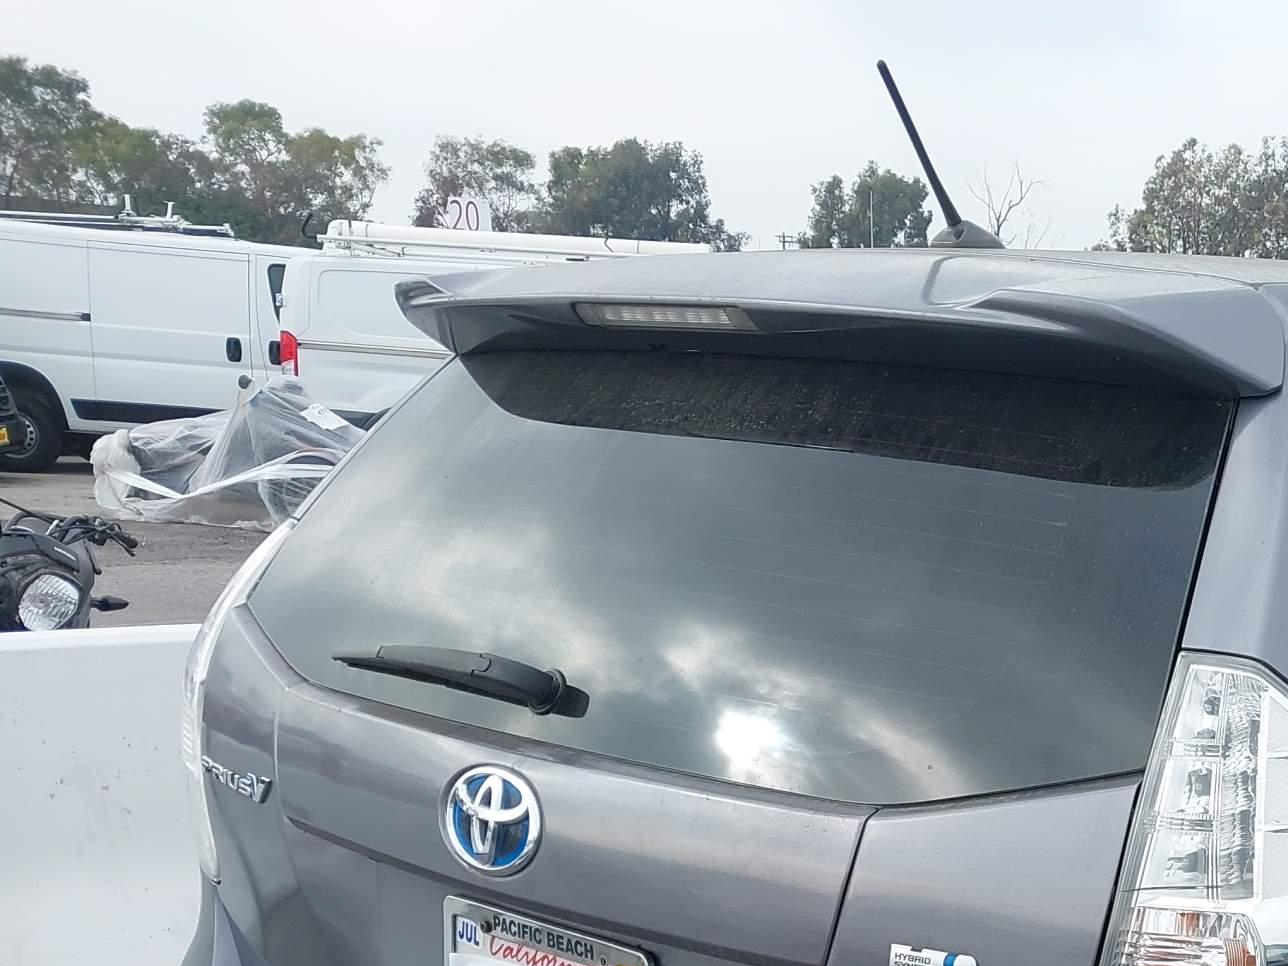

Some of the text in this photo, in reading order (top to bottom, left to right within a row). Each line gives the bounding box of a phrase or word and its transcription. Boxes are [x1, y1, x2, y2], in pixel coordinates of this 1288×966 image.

[450, 199, 480, 231] 20
[458, 920, 480, 947] JUL
[492, 914, 595, 961] PACIFIC BEACH
[894, 952, 932, 965] HYBRID
